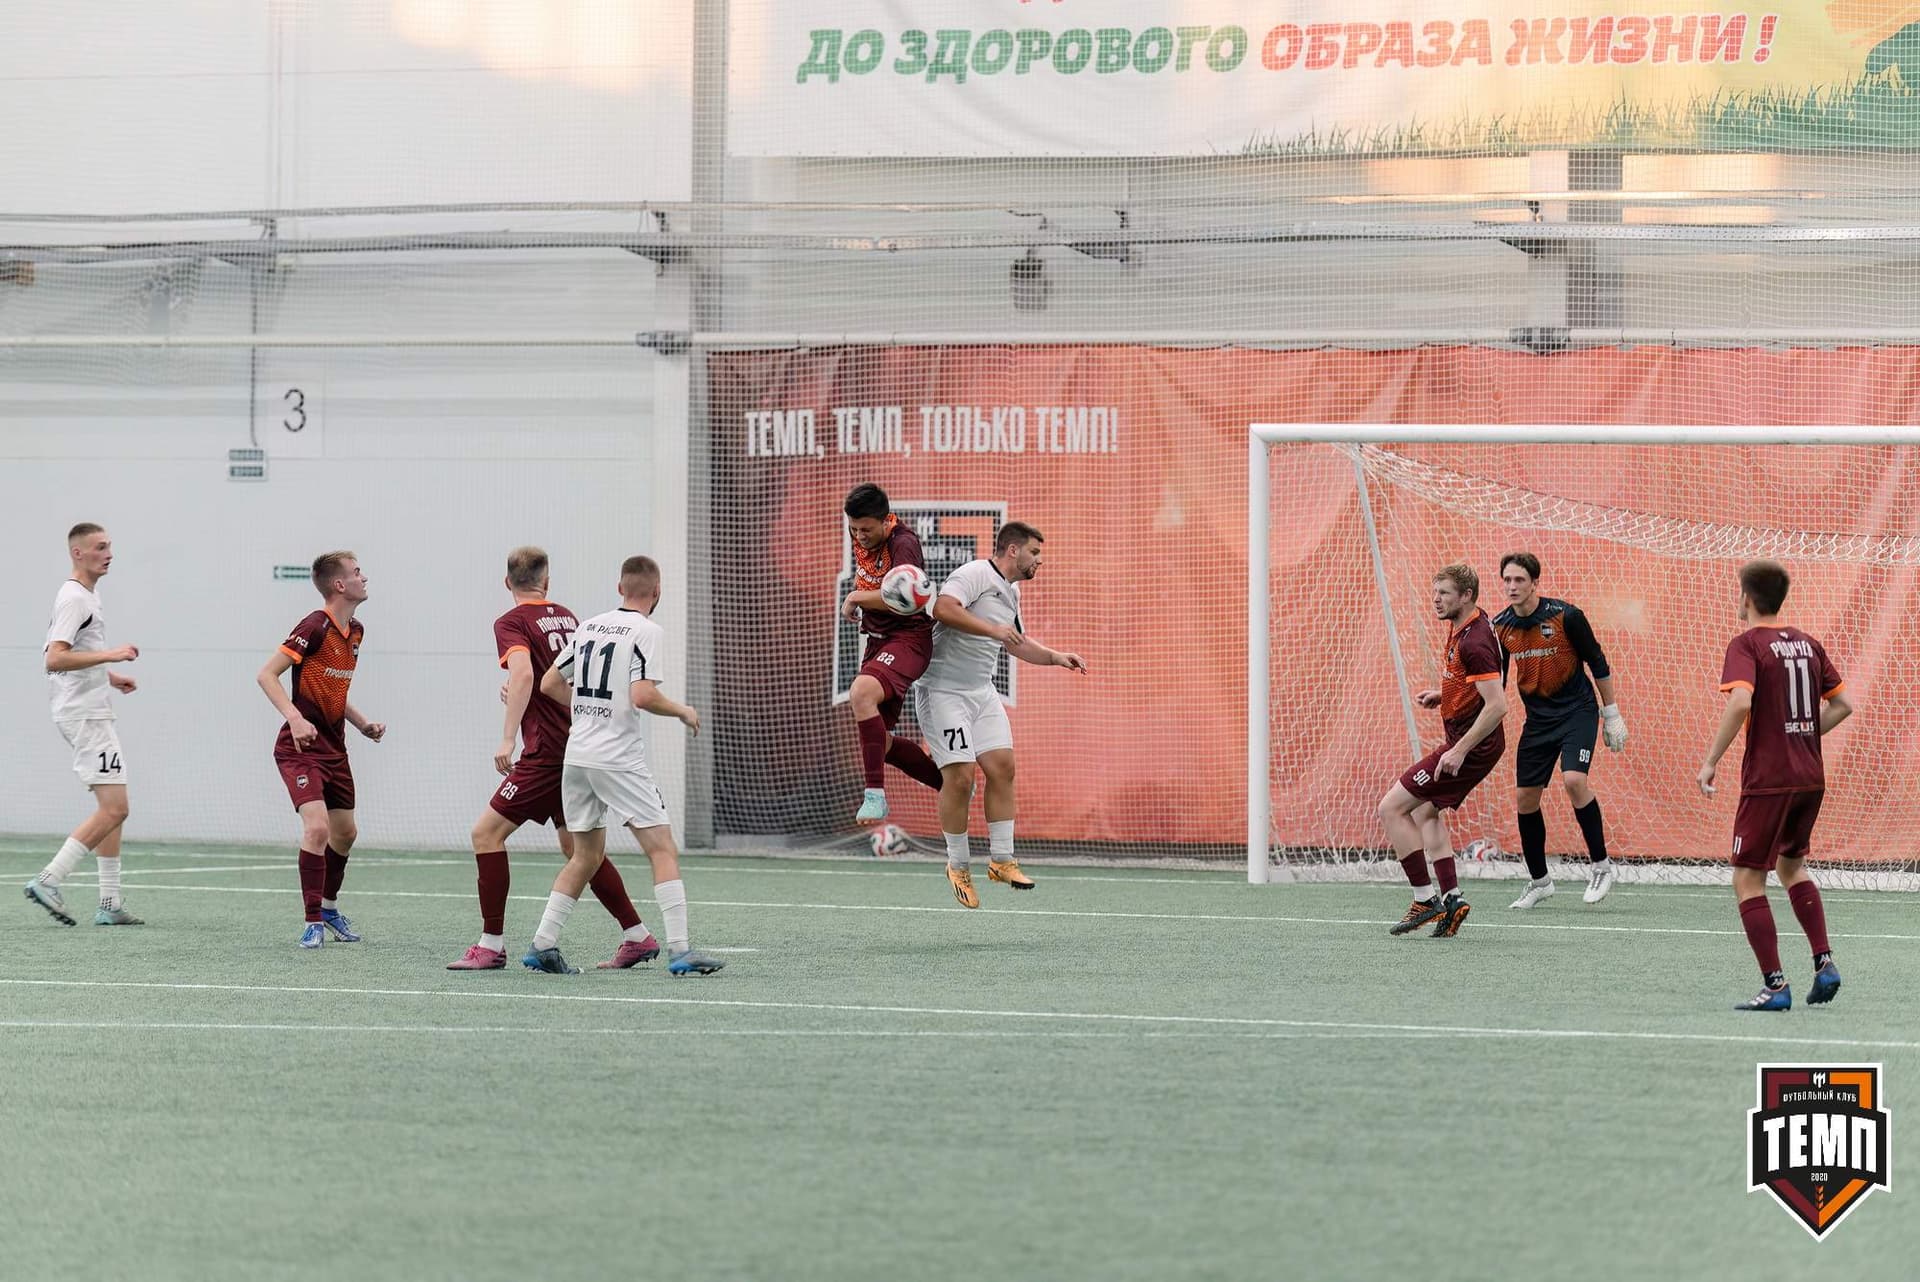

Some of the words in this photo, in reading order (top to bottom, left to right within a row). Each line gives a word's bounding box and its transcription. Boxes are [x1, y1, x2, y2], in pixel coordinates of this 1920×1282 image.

[796, 29, 885, 84] ДО
[893, 25, 1248, 84] ЗДОРОВОГО
[1261, 18, 1492, 71] ОБРАЗА
[284, 388, 306, 432] 3
[745, 408, 825, 459] ТЕМП,
[833, 406, 911, 458] ТЕМП,
[920, 405, 1026, 454] ТОЛЬКО
[1034, 406, 1118, 454] ТЕМП!
[577, 640, 617, 700] 11
[876, 651, 895, 667] 82
[1784, 658, 1812, 719] 11
[943, 727, 968, 751] 71
[98, 752, 122, 773] 14
[1412, 769, 1431, 786] 90
